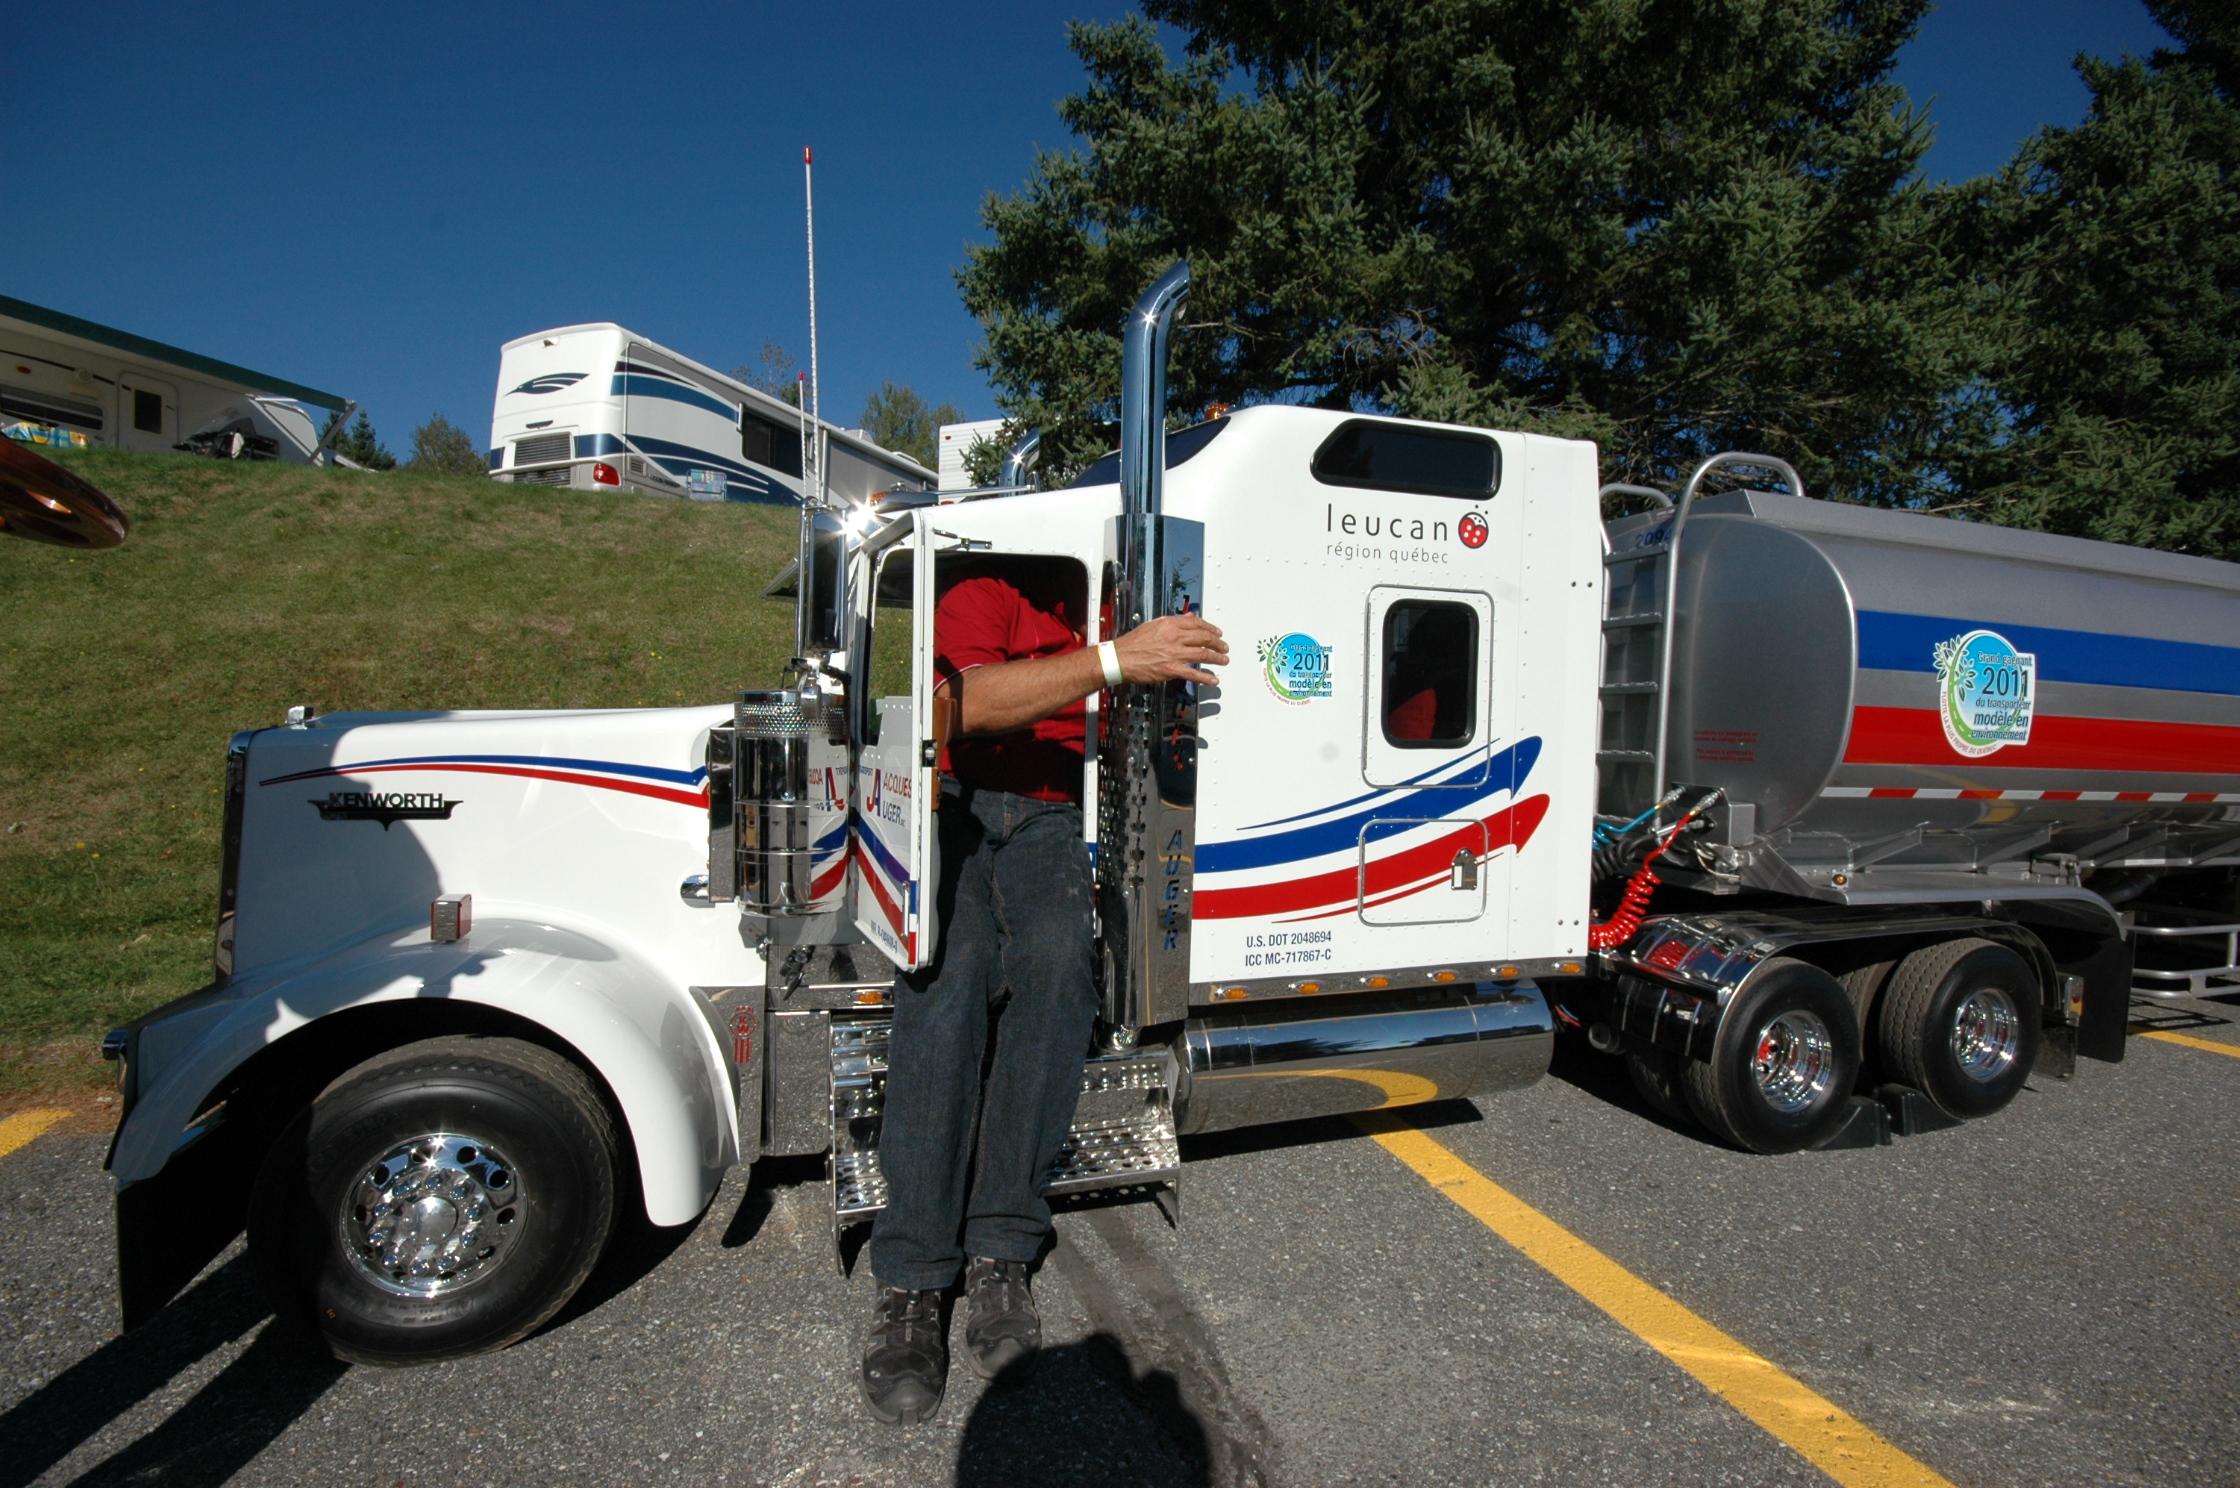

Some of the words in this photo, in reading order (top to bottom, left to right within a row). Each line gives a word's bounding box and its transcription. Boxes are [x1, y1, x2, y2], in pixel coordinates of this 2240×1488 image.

[1327, 503, 1448, 541] leucan
[1327, 541, 1382, 561] région
[1389, 547, 1448, 564] québec
[1293, 652, 1329, 671] 2011
[1978, 652, 2000, 664] Grand
[2003, 655, 2032, 666] gagnant
[1289, 678, 1320, 689] modèle
[1322, 681, 1332, 689] en
[1982, 667, 2028, 697] 2011
[1976, 697, 1985, 707] du
[1987, 698, 2031, 710] transporteur
[1974, 711, 2013, 726] modèle
[2016, 716, 2029, 727] en
[1971, 728, 2027, 740] environnement
[328, 792, 443, 809] KENWORTH
[1163, 829, 1183, 951] AUGER
[1246, 935, 1266, 948] U.S.
[1268, 933, 1288, 947] DOT
[1290, 930, 1332, 945] 2048694
[1245, 954, 1262, 967] ICC
[1265, 949, 1331, 965] MC-717867-C
